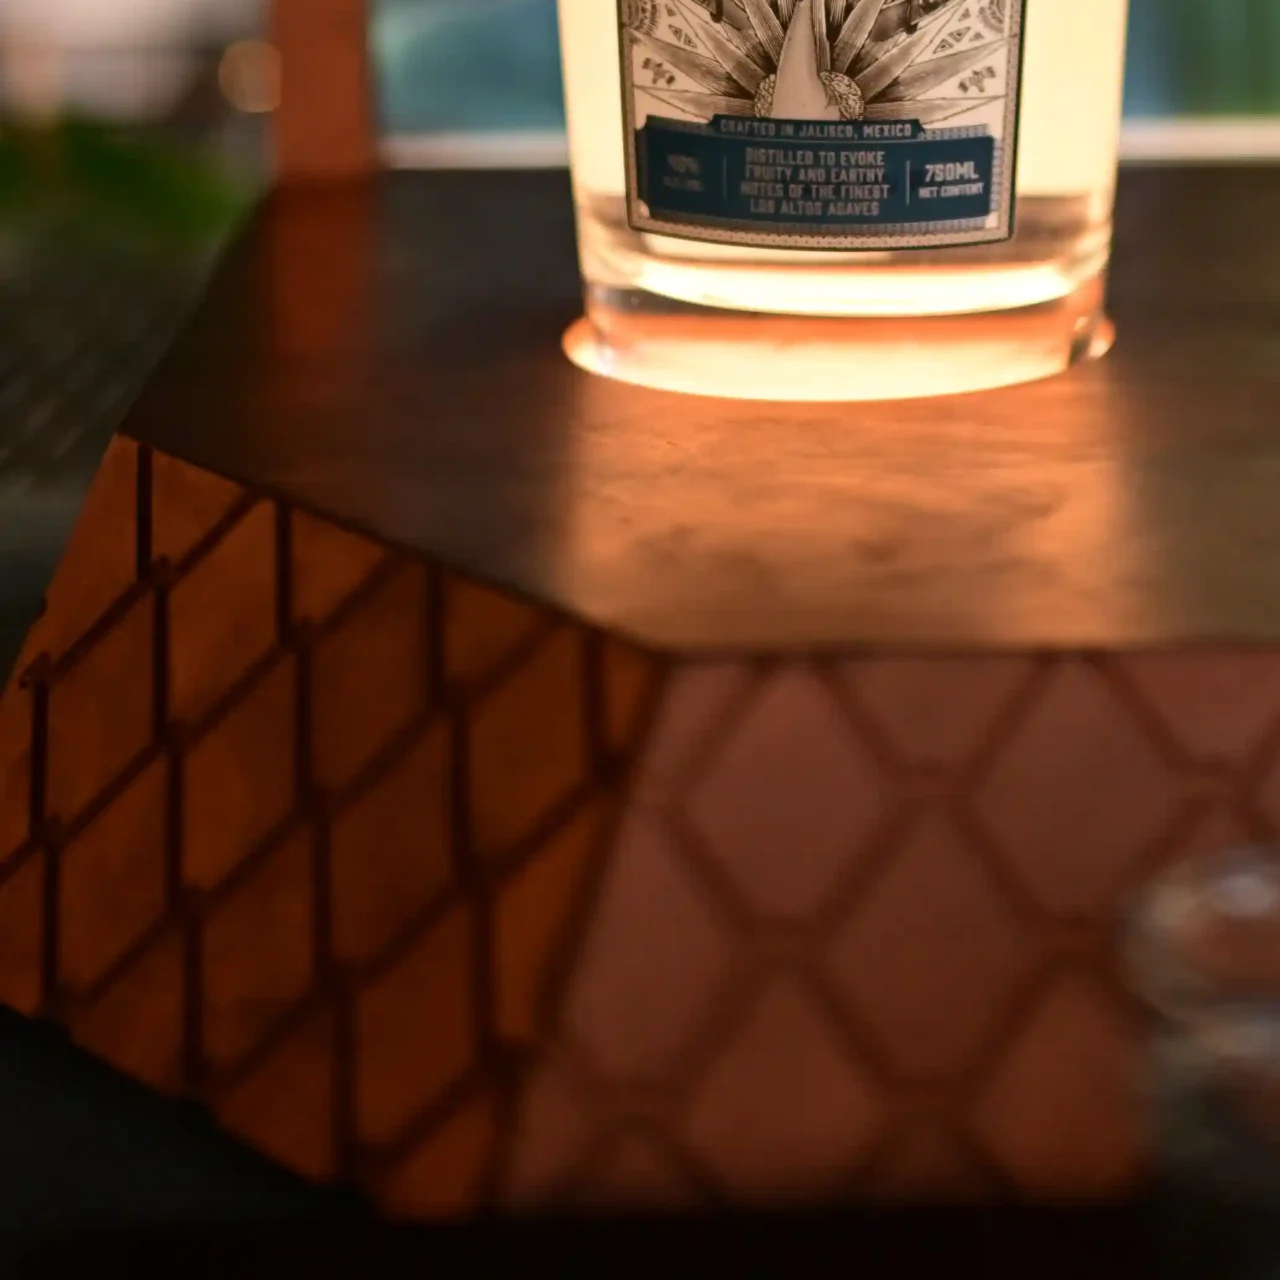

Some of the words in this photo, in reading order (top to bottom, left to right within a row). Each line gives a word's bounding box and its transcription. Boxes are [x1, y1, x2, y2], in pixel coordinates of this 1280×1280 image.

[720, 118, 776, 138] CRAFTED
[781, 124, 795, 138] IN
[799, 124, 859, 140] JALISCO,
[863, 123, 912, 138] MEXICO
[818, 151, 836, 166] TO
[840, 150, 886, 166] EVOKE
[798, 167, 826, 182] AND
[831, 167, 884, 183] EARTHY
[924, 161, 980, 183] 750ML
[841, 183, 890, 200] FINEST
